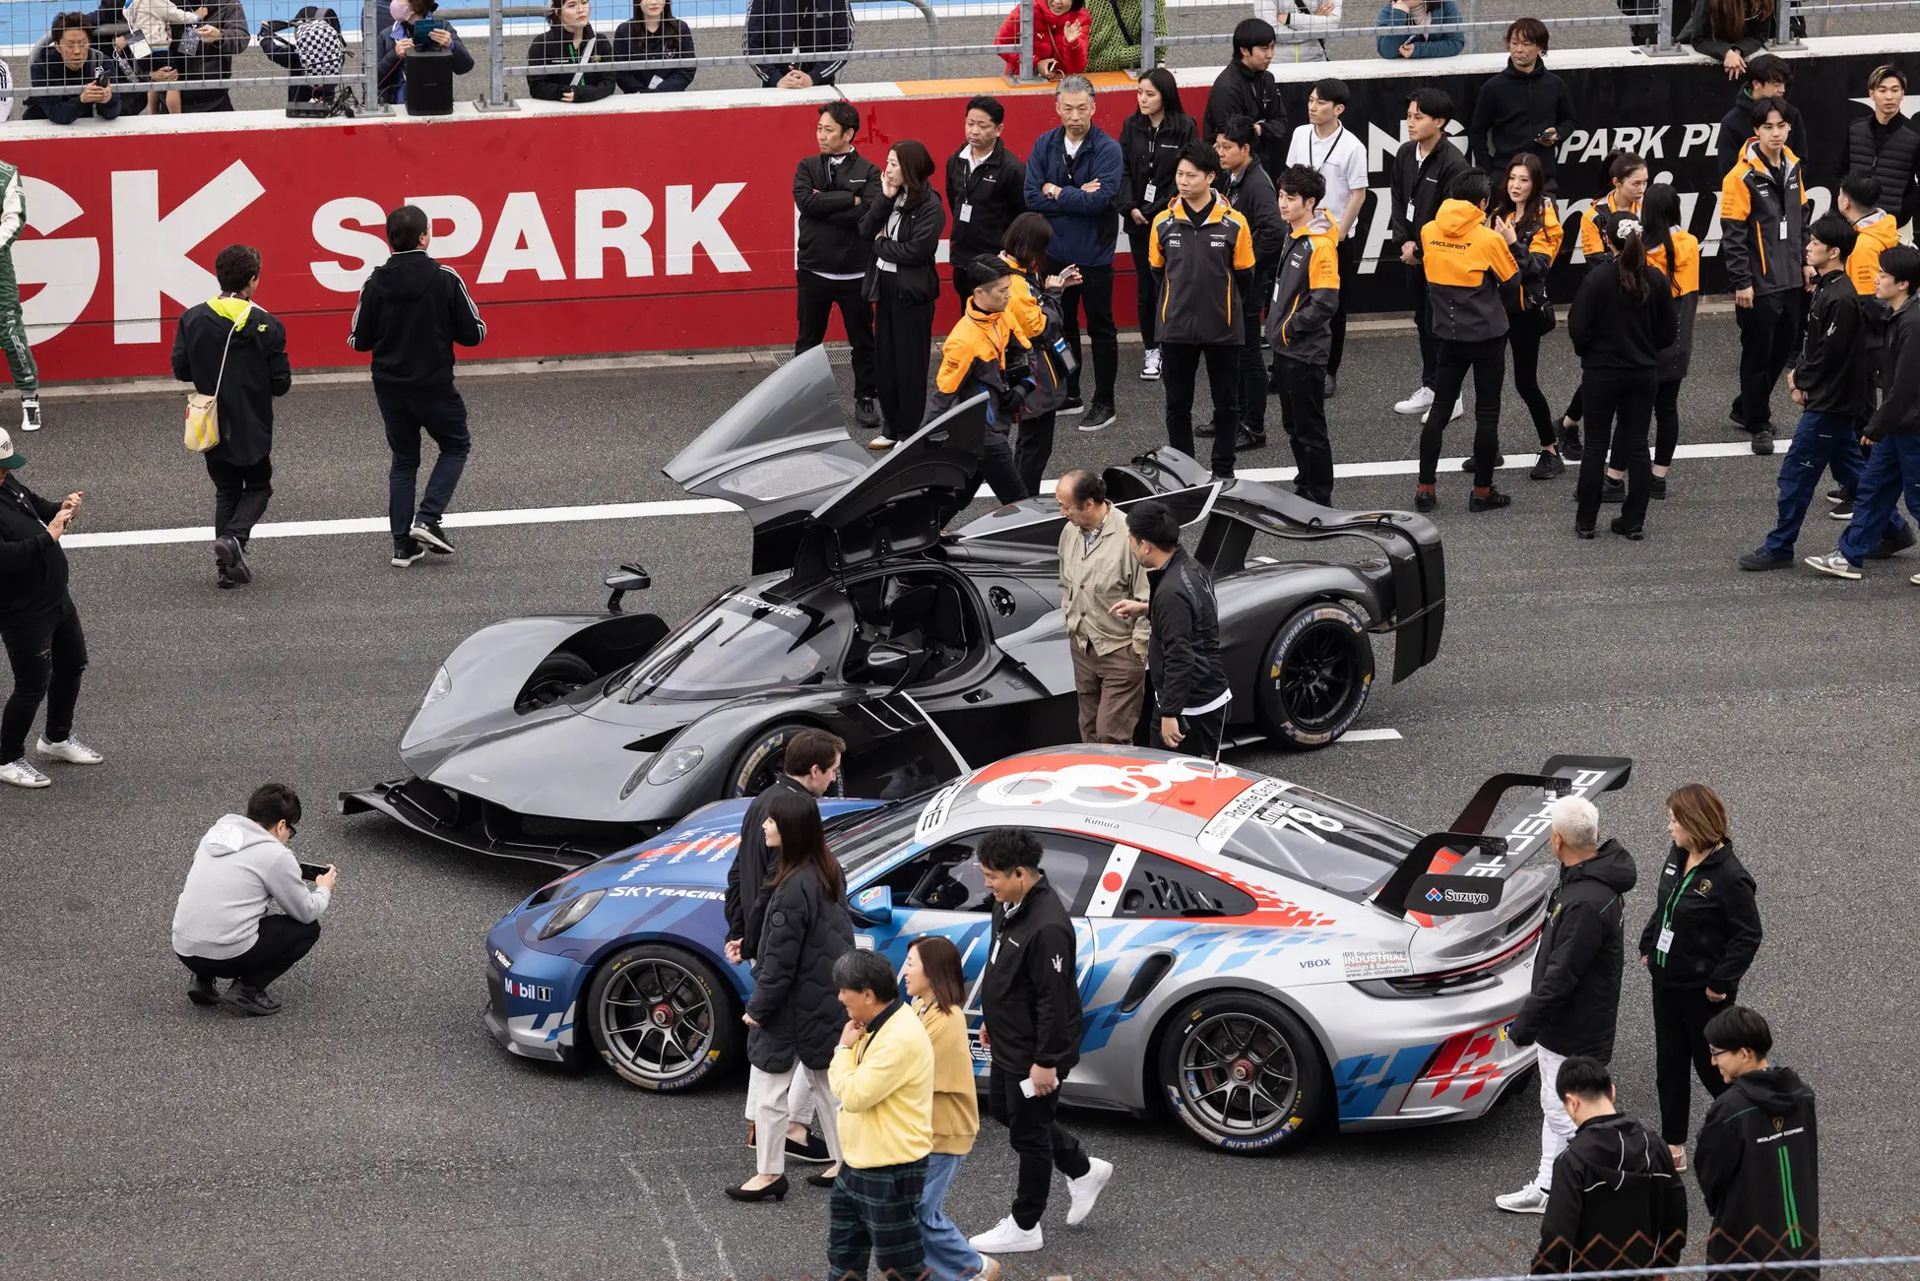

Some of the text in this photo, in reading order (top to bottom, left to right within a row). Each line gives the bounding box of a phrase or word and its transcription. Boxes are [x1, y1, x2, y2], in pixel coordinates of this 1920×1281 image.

[1554, 123, 1722, 164] PARK PL
[310, 182, 751, 293] SPARK
[1429, 240, 1466, 250] McLaren
[1279, 613, 1313, 658] MICHELIN
[1084, 816, 1120, 829] Kimura
[1271, 807, 1343, 845] 78
[1444, 889, 1489, 904] Suzuyo
[1299, 958, 1331, 969] VBOX
[1344, 955, 1406, 964] INDUSTRIAL
[504, 977, 535, 1000] Mobil
[662, 1064, 708, 1089] MICHELIN
[1226, 1131, 1284, 1150] MICHELIN
